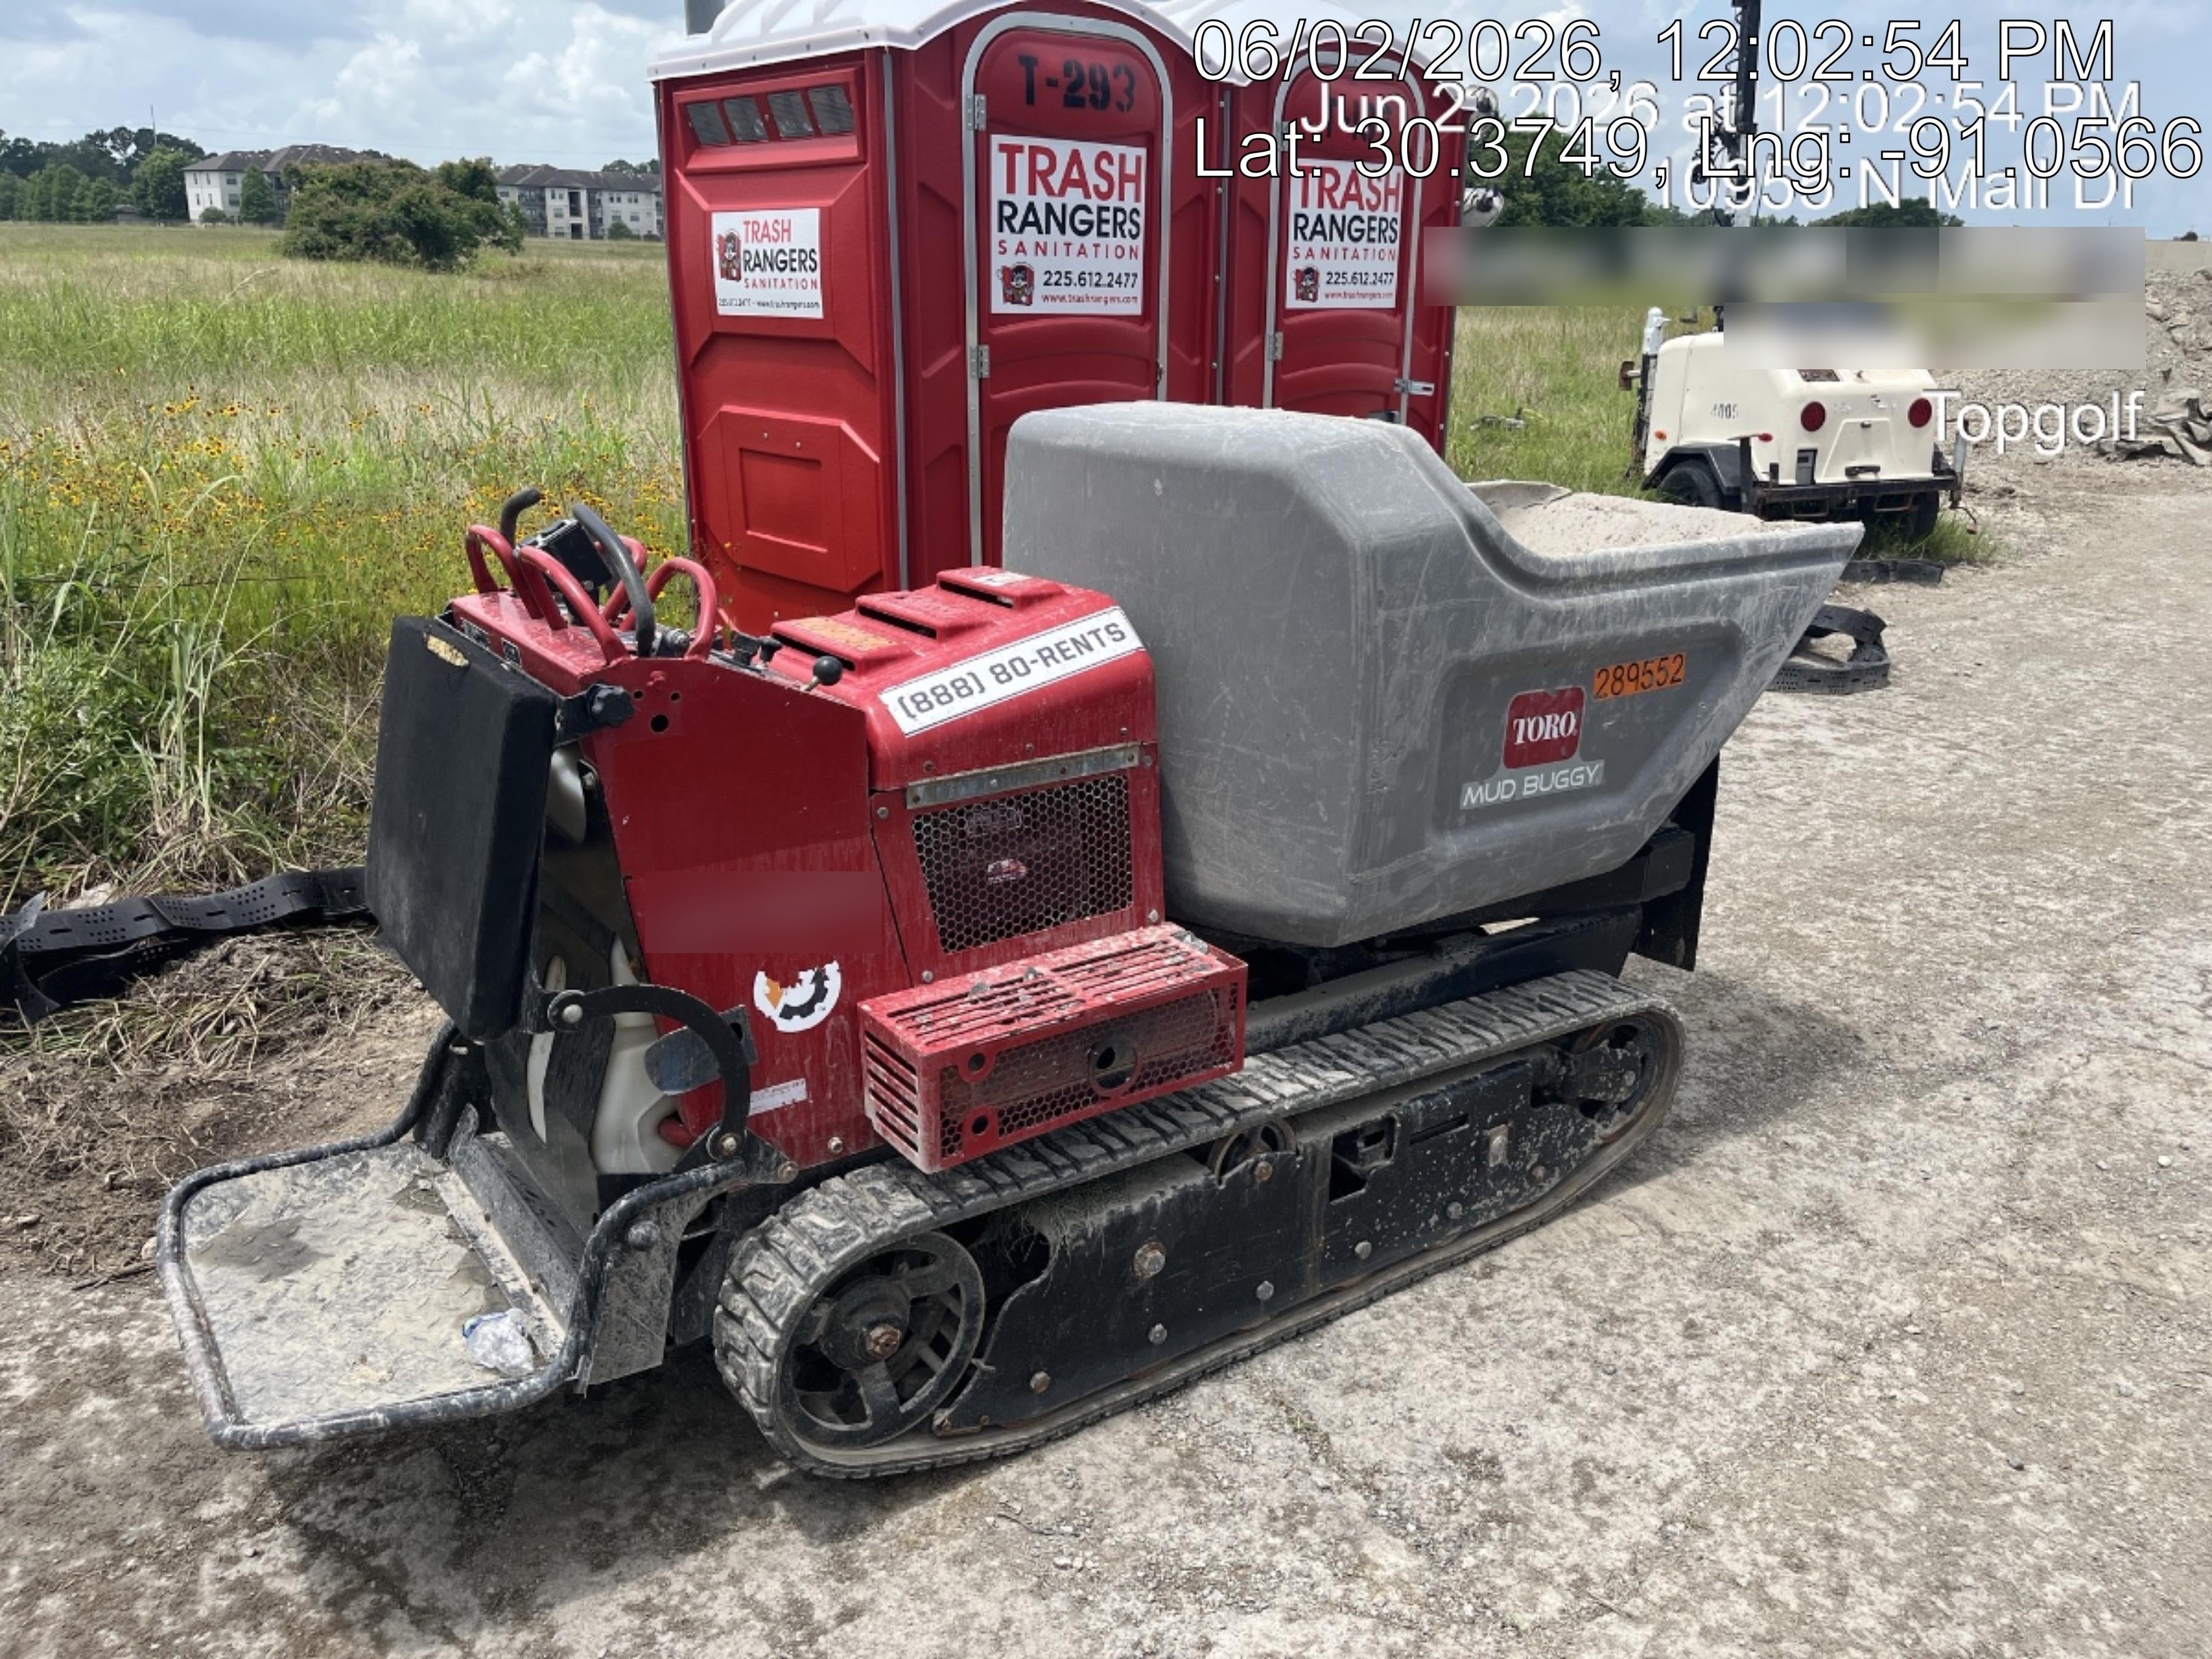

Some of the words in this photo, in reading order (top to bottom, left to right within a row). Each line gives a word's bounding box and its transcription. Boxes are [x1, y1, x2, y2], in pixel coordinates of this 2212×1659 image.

[1018, 55, 1136, 113] T-293
[998, 143, 1142, 203] TRASH
[1296, 164, 1401, 213] TRASH
[743, 219, 791, 243] TRASH
[997, 200, 1141, 240] RANGERS
[1293, 213, 1398, 244] RANGERS
[743, 248, 817, 273] RANGERS
[998, 240, 1139, 260] SANITATION
[1293, 246, 1396, 261] SANITATION
[743, 278, 818, 289] SANITATION
[1043, 270, 1139, 288] 225.612.2477
[897, 672, 986, 720] (888)
[989, 622, 1127, 685] 80-RENTS
[1594, 654, 1684, 699] 289552
[1513, 711, 1577, 745] TORO
[1463, 779, 1517, 806] MUD
[1523, 765, 1599, 795] BUGGY
